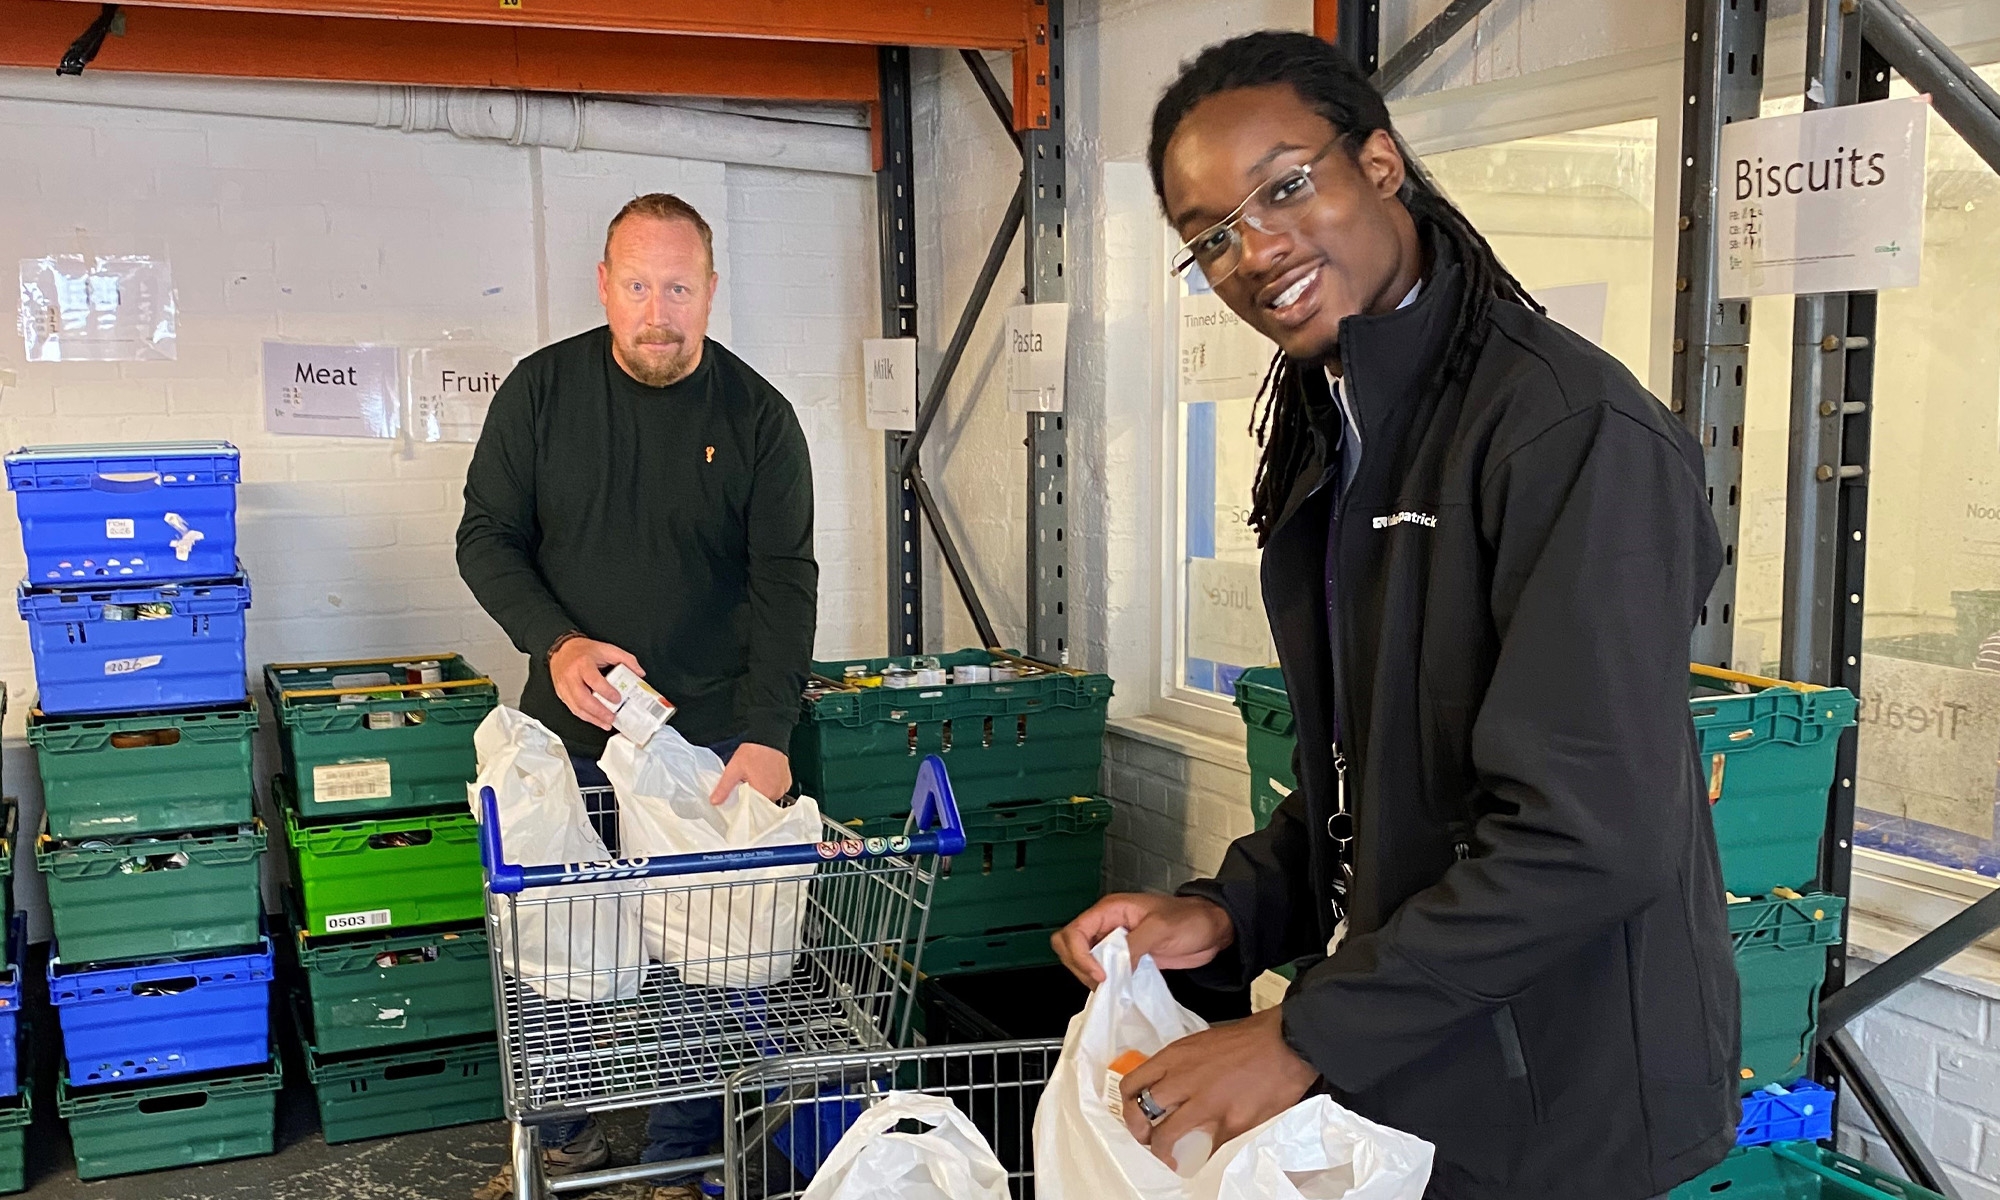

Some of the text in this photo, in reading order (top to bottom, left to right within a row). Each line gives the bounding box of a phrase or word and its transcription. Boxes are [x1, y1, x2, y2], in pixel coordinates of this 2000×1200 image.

[1736, 147, 1885, 200] Biscuits
[1184, 312, 1216, 328] Tinned
[1013, 329, 1043, 353] Pasta
[295, 362, 358, 386] Meat
[873, 358, 894, 380] Milk
[442, 371, 500, 393] Fruit
[111, 658, 142, 671] 2026
[563, 857, 650, 875] TESCO
[329, 916, 366, 928] 0503
